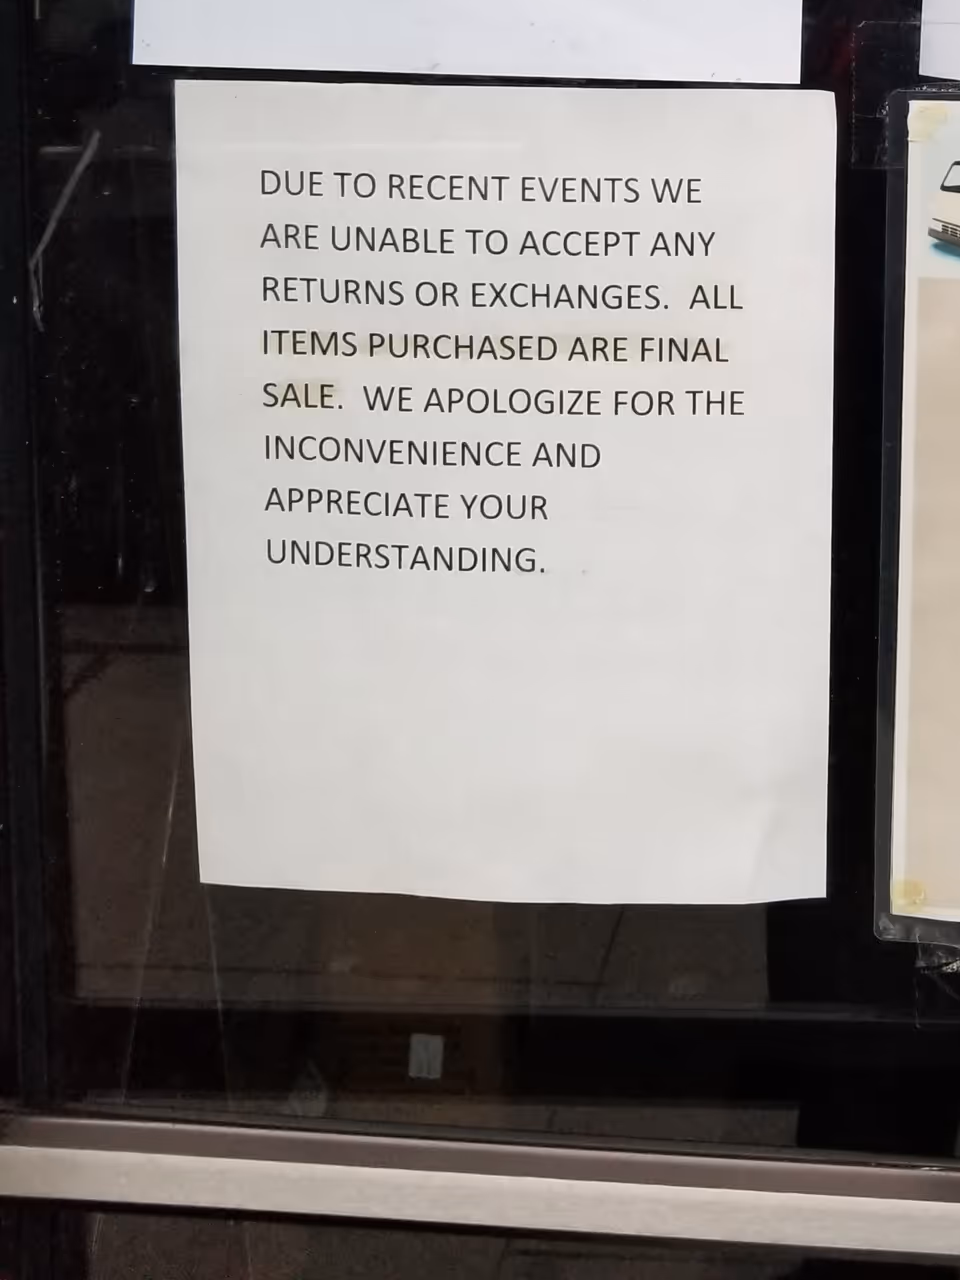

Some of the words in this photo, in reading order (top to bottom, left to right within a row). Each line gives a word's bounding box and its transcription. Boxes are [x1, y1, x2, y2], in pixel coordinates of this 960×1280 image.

[261, 169, 324, 197] DUE
[333, 172, 376, 199] TO
[388, 173, 510, 201] RECENT
[521, 176, 640, 204] EVENTS
[650, 178, 702, 204] WE
[260, 223, 319, 250] ARE
[331, 225, 455, 254] UNABLE
[464, 229, 508, 255] TO
[519, 230, 641, 257] ACCEPT
[649, 231, 716, 257] ANY
[262, 276, 405, 306] RETURNS
[415, 281, 460, 307] OR
[471, 282, 669, 310] EXCHANGES.
[689, 284, 744, 310] ALL
[263, 329, 358, 357] ITEMS
[369, 332, 558, 361] PURCHASED
[567, 336, 628, 362] ARE
[640, 337, 729, 363] FINAL
[262, 382, 343, 410] SALE.
[362, 385, 413, 412] WE
[423, 387, 602, 416] APOLOGIZE
[614, 390, 675, 416] FOR
[684, 390, 745, 416] THE
[265, 434, 522, 467] INCONVENIENCE
[531, 442, 601, 468] AND
[264, 487, 450, 519] APPRECIATE
[460, 494, 548, 520] YOUR
[267, 538, 545, 573] UNDERSTANDING.
